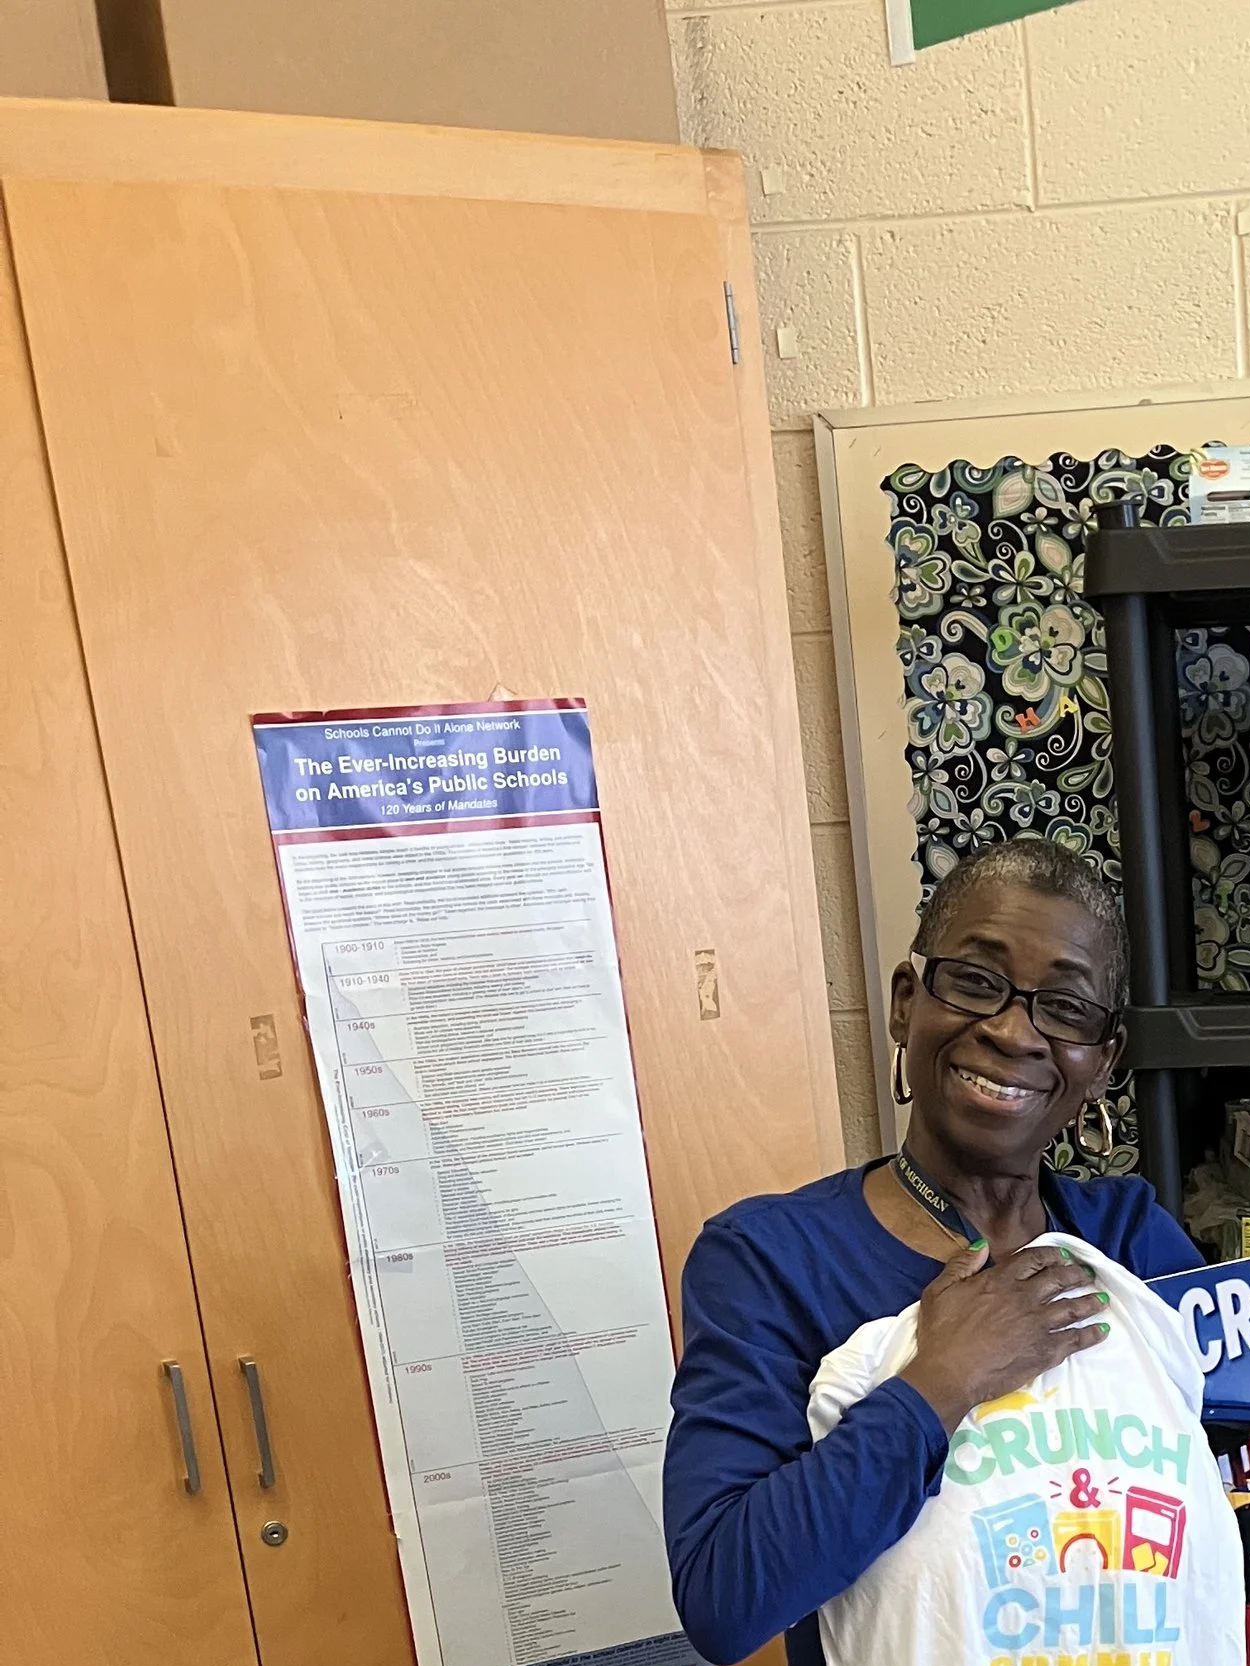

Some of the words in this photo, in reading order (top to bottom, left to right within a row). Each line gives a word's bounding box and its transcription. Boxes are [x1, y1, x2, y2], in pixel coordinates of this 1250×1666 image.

[325, 727, 369, 740] Schools
[373, 725, 413, 737] Cannot
[416, 724, 431, 735] Do
[444, 721, 474, 733] Alone
[476, 718, 521, 732] Network
[294, 757, 334, 777] The
[338, 747, 488, 775] Ever-Increasing
[493, 745, 562, 765] Burden
[296, 784, 321, 802] on
[327, 777, 424, 800] America's
[429, 773, 488, 795] Public
[493, 768, 568, 790] Schools
[380, 804, 400, 816] 120
[402, 802, 432, 814] Years
[434, 801, 446, 812] of
[448, 798, 498, 811] Mandates
[346, 1020, 376, 1032] 1940s
[353, 1064, 383, 1077] 1950s
[361, 1107, 390, 1120] 1960s
[370, 1165, 400, 1178] 1970s
[905, 1166, 951, 1212] MICHIGAN
[404, 1362, 433, 1375] 1990s
[944, 1407, 1192, 1486] CRUNCH
[423, 1470, 452, 1484] 2000s
[1069, 1467, 1102, 1509] &
[983, 1581, 1181, 1650] CHILL
